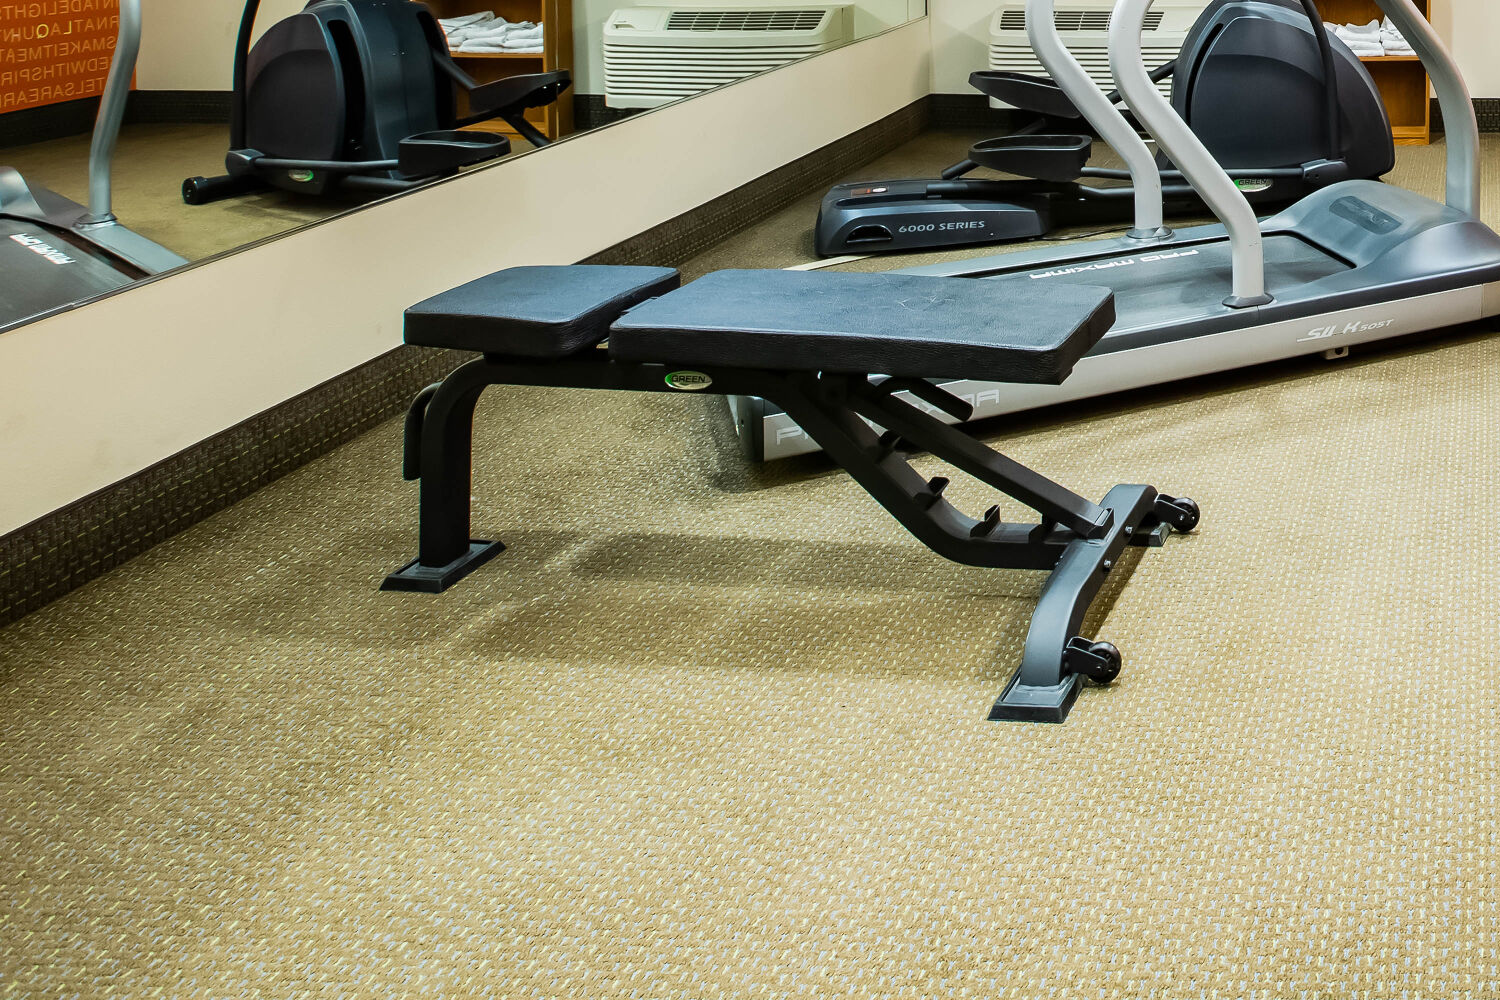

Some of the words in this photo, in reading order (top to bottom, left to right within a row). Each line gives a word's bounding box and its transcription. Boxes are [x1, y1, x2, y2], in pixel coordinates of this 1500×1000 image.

[898, 224, 935, 233] 6000
[938, 220, 985, 231] SERIES
[671, 374, 706, 384] GREEN
